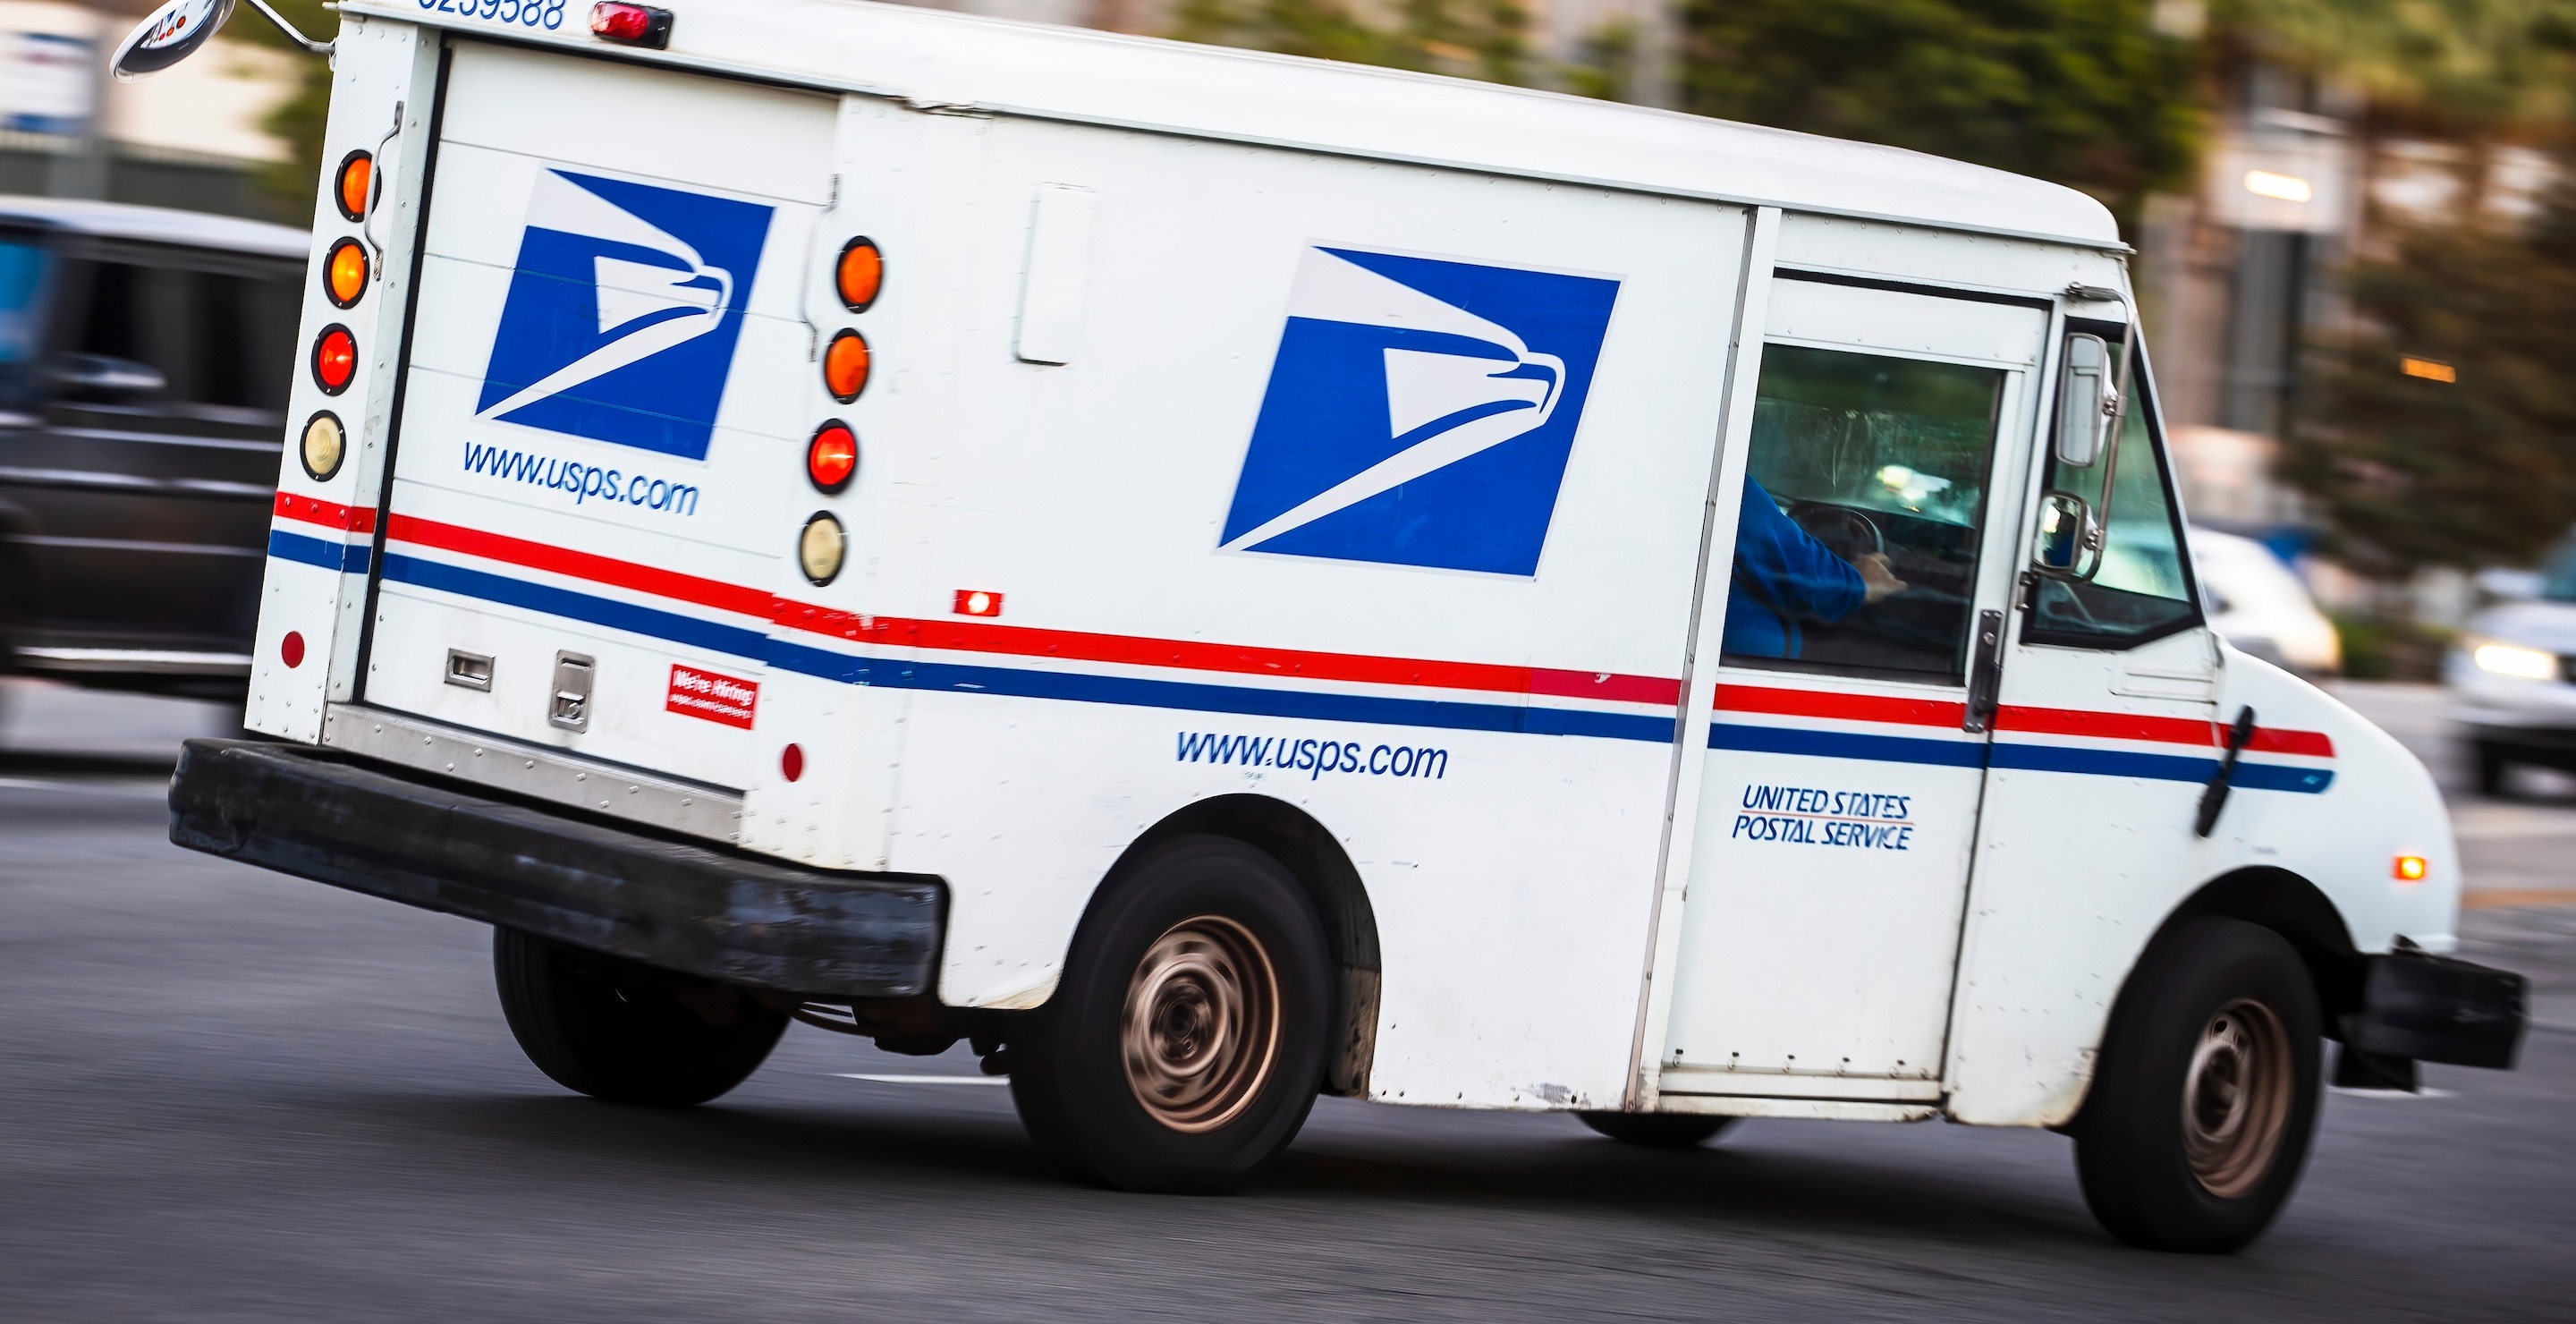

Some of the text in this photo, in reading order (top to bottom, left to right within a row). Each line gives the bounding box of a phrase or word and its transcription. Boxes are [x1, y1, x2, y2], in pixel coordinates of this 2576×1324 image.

[419, 0, 563, 30] 9588
[464, 441, 699, 516] www.usps.com
[710, 678, 756, 707] Hiring
[1176, 731, 1448, 781] www.usps.com
[1742, 784, 1911, 819] UNITED STATES
[1732, 814, 1914, 850] POSTAL SERVICE
